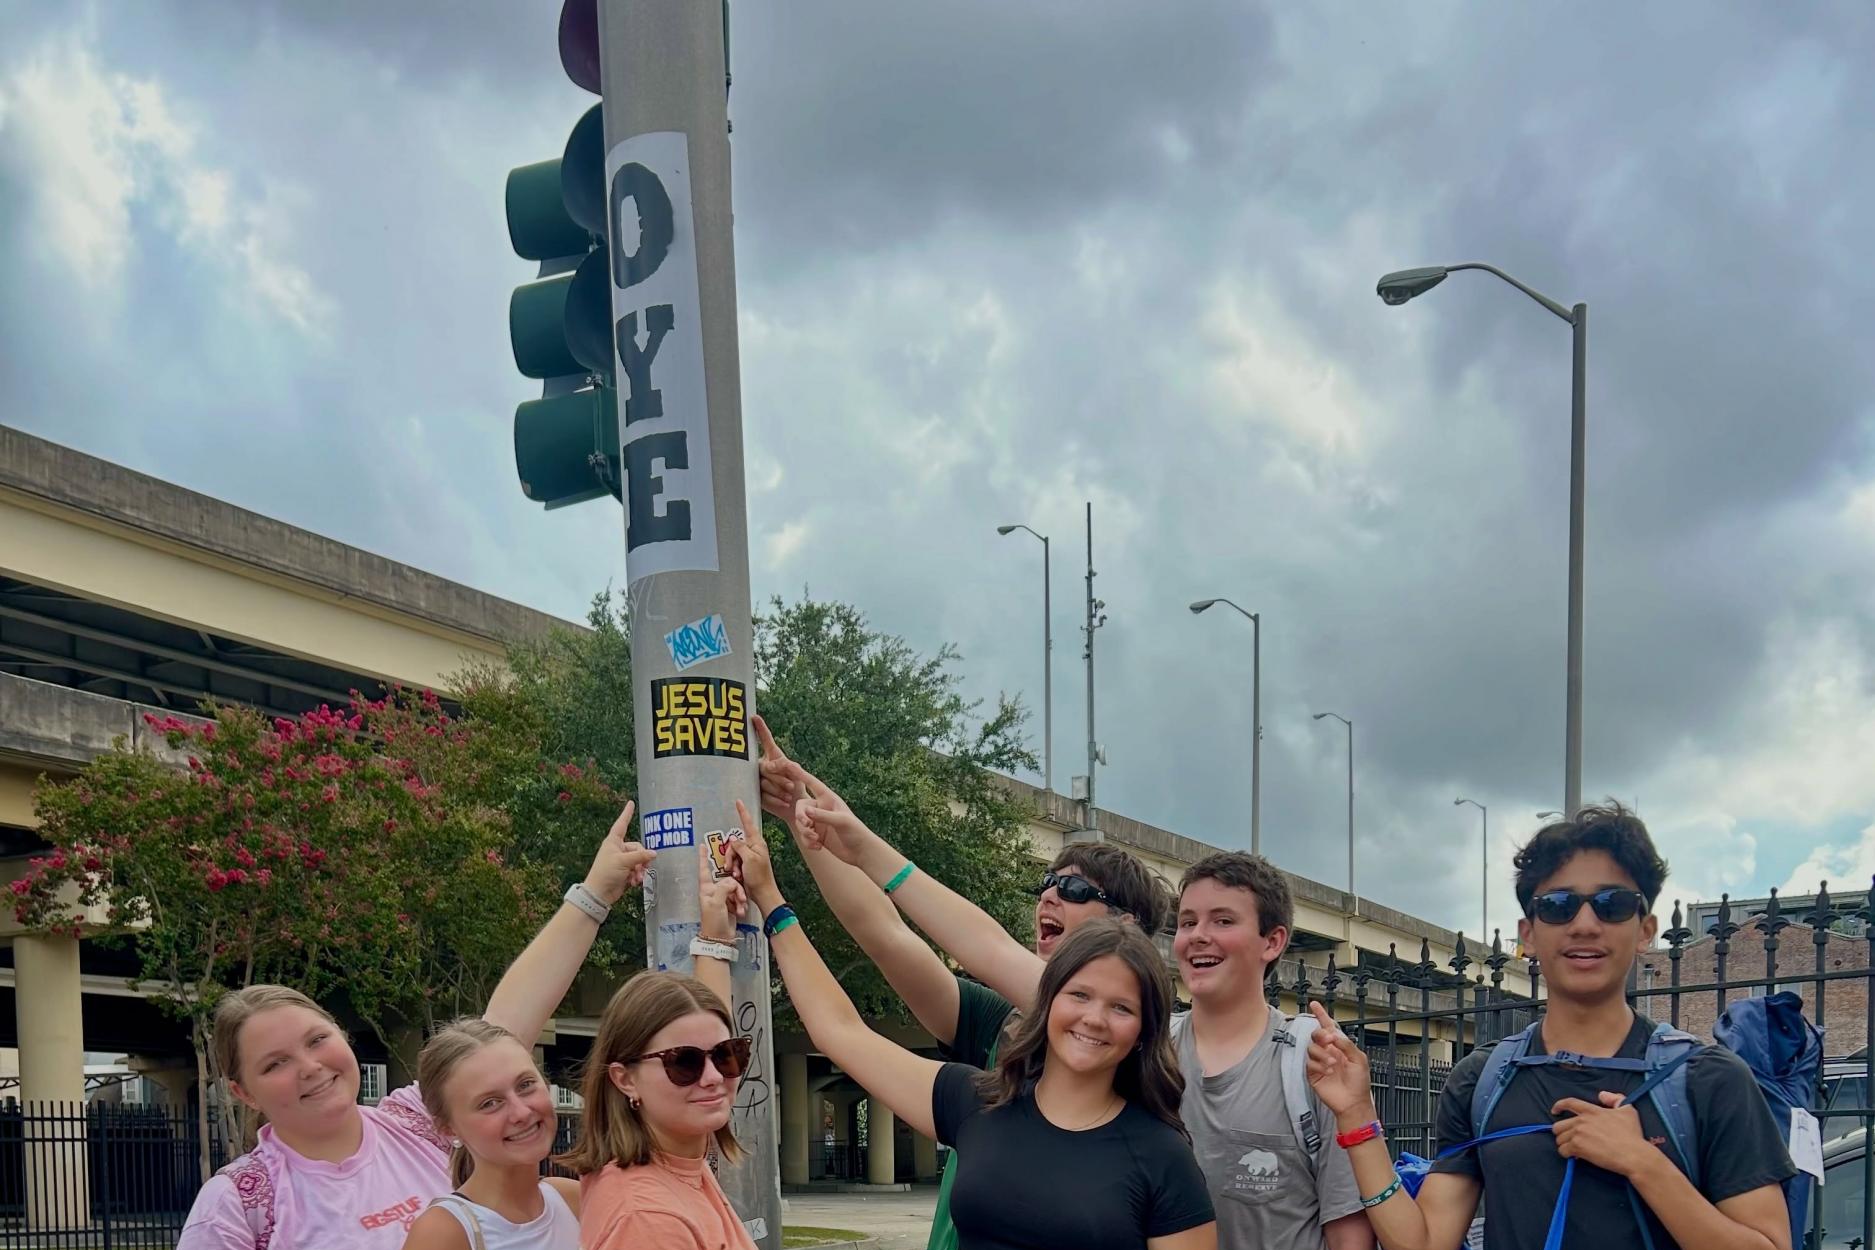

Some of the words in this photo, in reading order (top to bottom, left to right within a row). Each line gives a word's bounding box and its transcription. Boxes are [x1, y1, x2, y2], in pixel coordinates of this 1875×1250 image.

[656, 682, 744, 720] JESUS
[656, 717, 746, 753] SAVES
[663, 811, 691, 830] ONE
[646, 834, 661, 849] TOP
[663, 831, 690, 846] MOB
